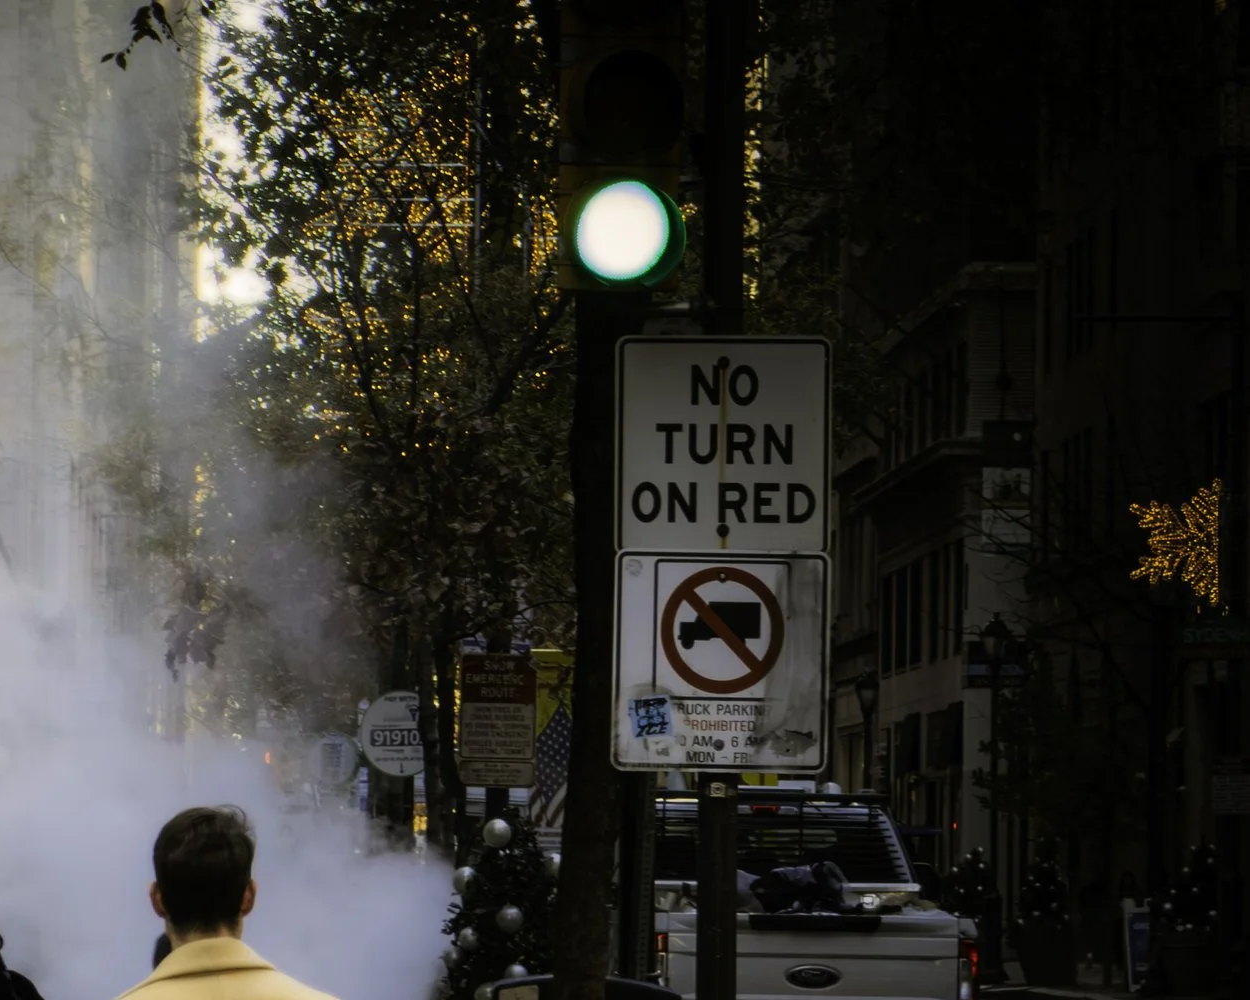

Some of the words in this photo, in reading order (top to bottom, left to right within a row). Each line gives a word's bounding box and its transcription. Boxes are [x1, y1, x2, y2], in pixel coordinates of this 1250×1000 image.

[691, 365, 759, 406] NO
[656, 423, 794, 465] TURN
[631, 481, 698, 524] ON
[718, 482, 816, 524] RED
[373, 729, 424, 746] 91910
[692, 735, 713, 747] AM
[730, 735, 739, 748] 6
[686, 750, 716, 763] MON
